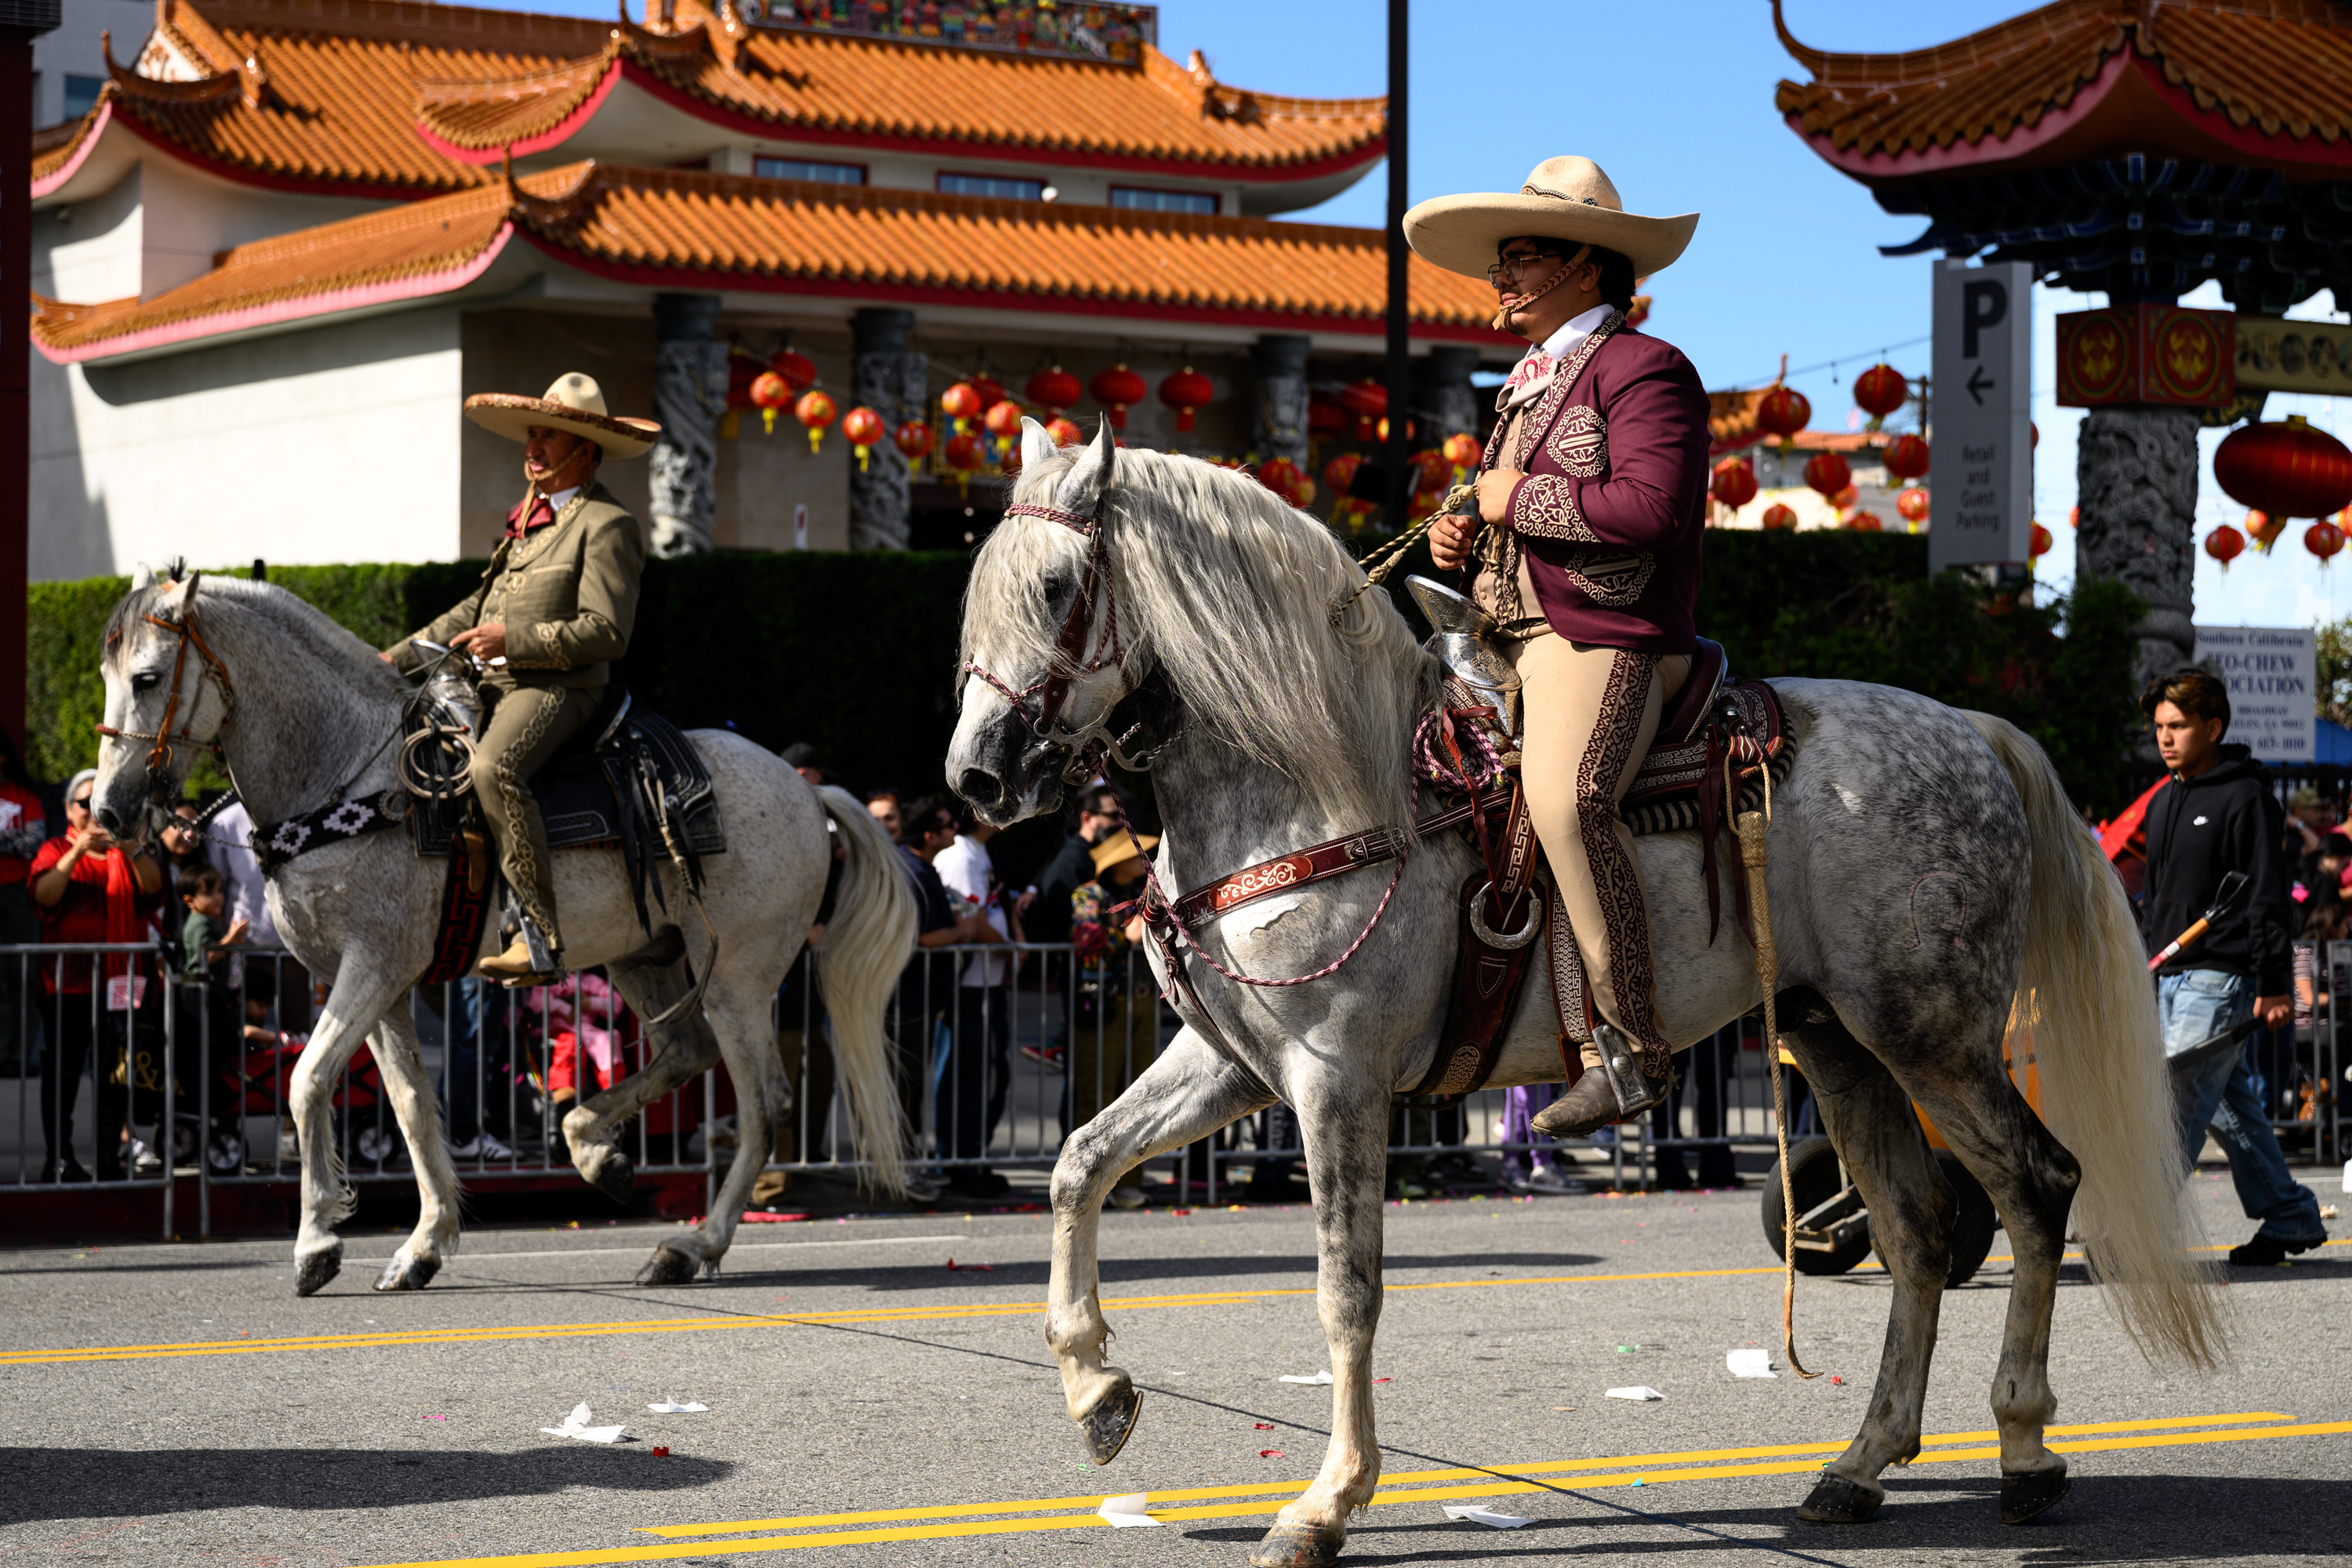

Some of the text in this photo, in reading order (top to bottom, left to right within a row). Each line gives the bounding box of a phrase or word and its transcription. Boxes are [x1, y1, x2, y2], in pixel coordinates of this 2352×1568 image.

[1962, 279, 2006, 358] P
[1962, 444, 1995, 463] Retail
[1966, 466, 1989, 485] and
[1960, 488, 1996, 509] Guest
[1955, 510, 1999, 534] Parking
[2197, 630, 2304, 648] Southern California
